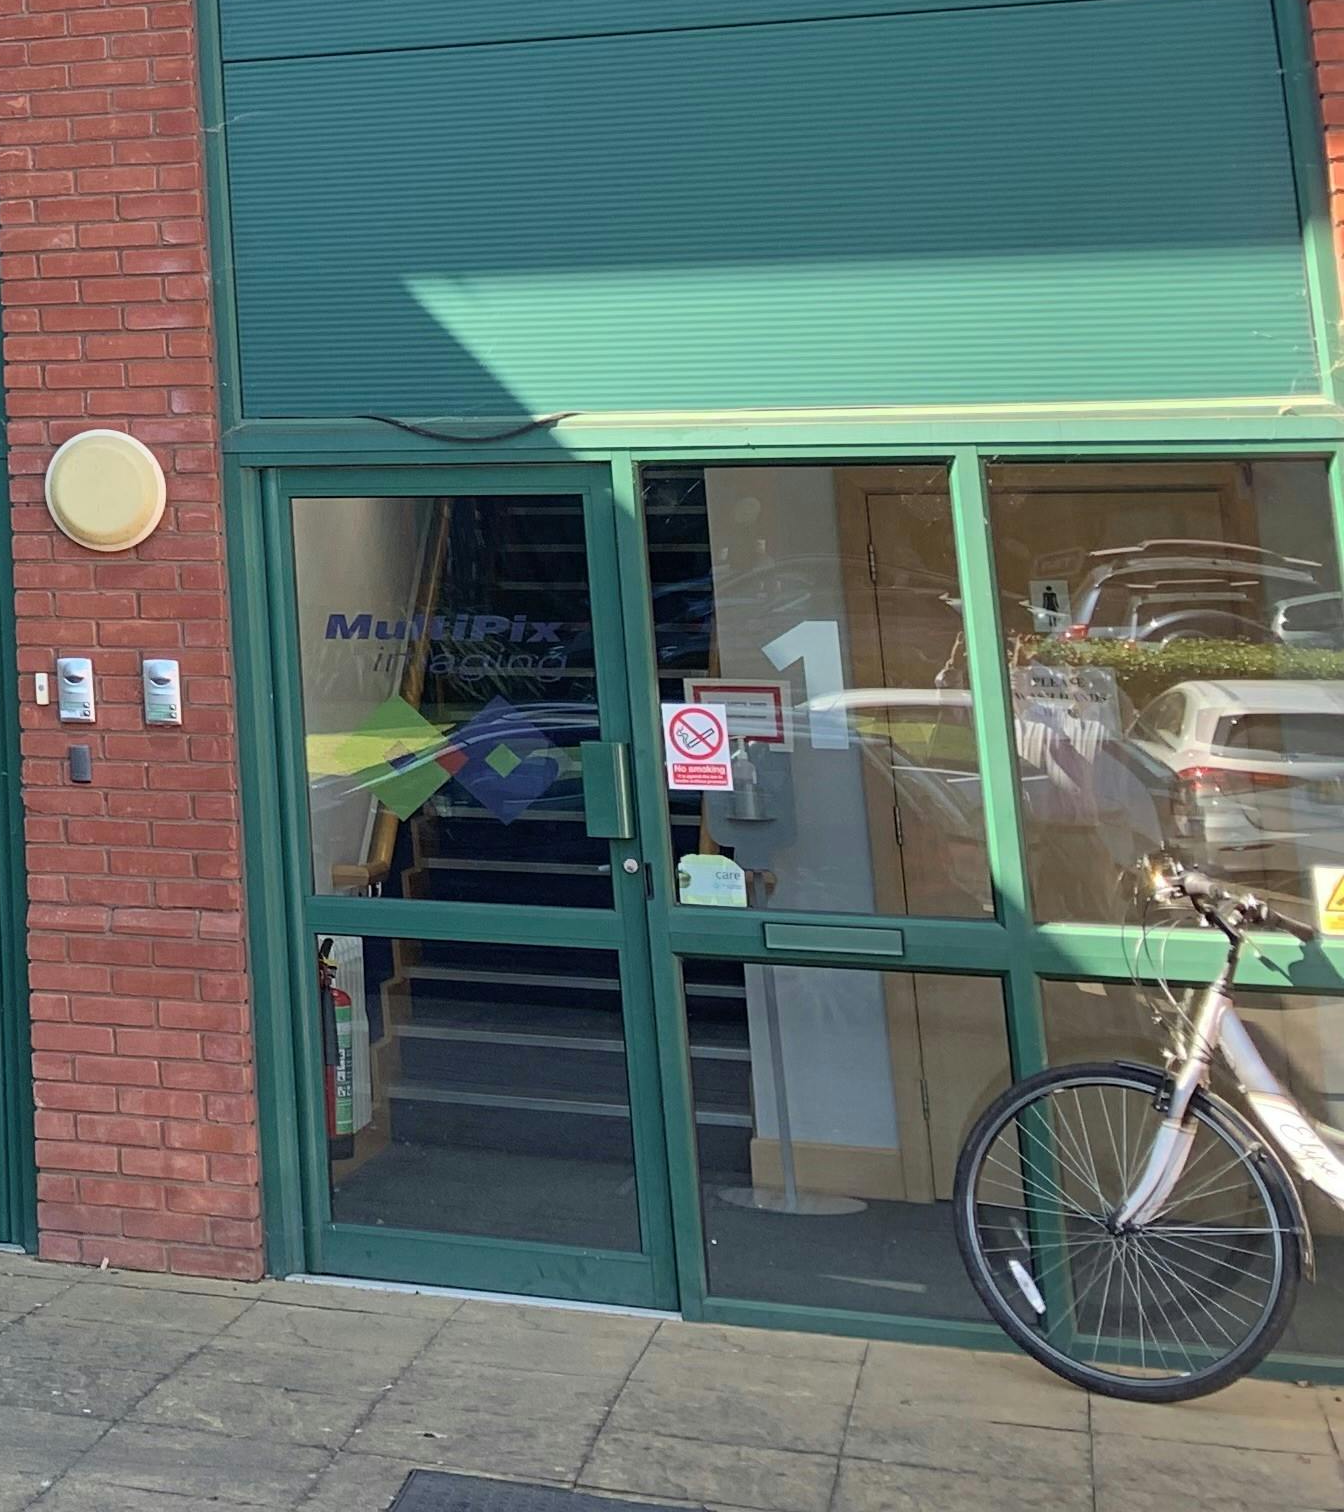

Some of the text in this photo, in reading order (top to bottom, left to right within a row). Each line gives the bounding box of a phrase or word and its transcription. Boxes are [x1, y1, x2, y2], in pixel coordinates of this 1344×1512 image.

[325, 613, 563, 643] MultiPix
[761, 620, 850, 750] 1
[673, 764, 726, 776] No smoking
[715, 871, 741, 881] care
